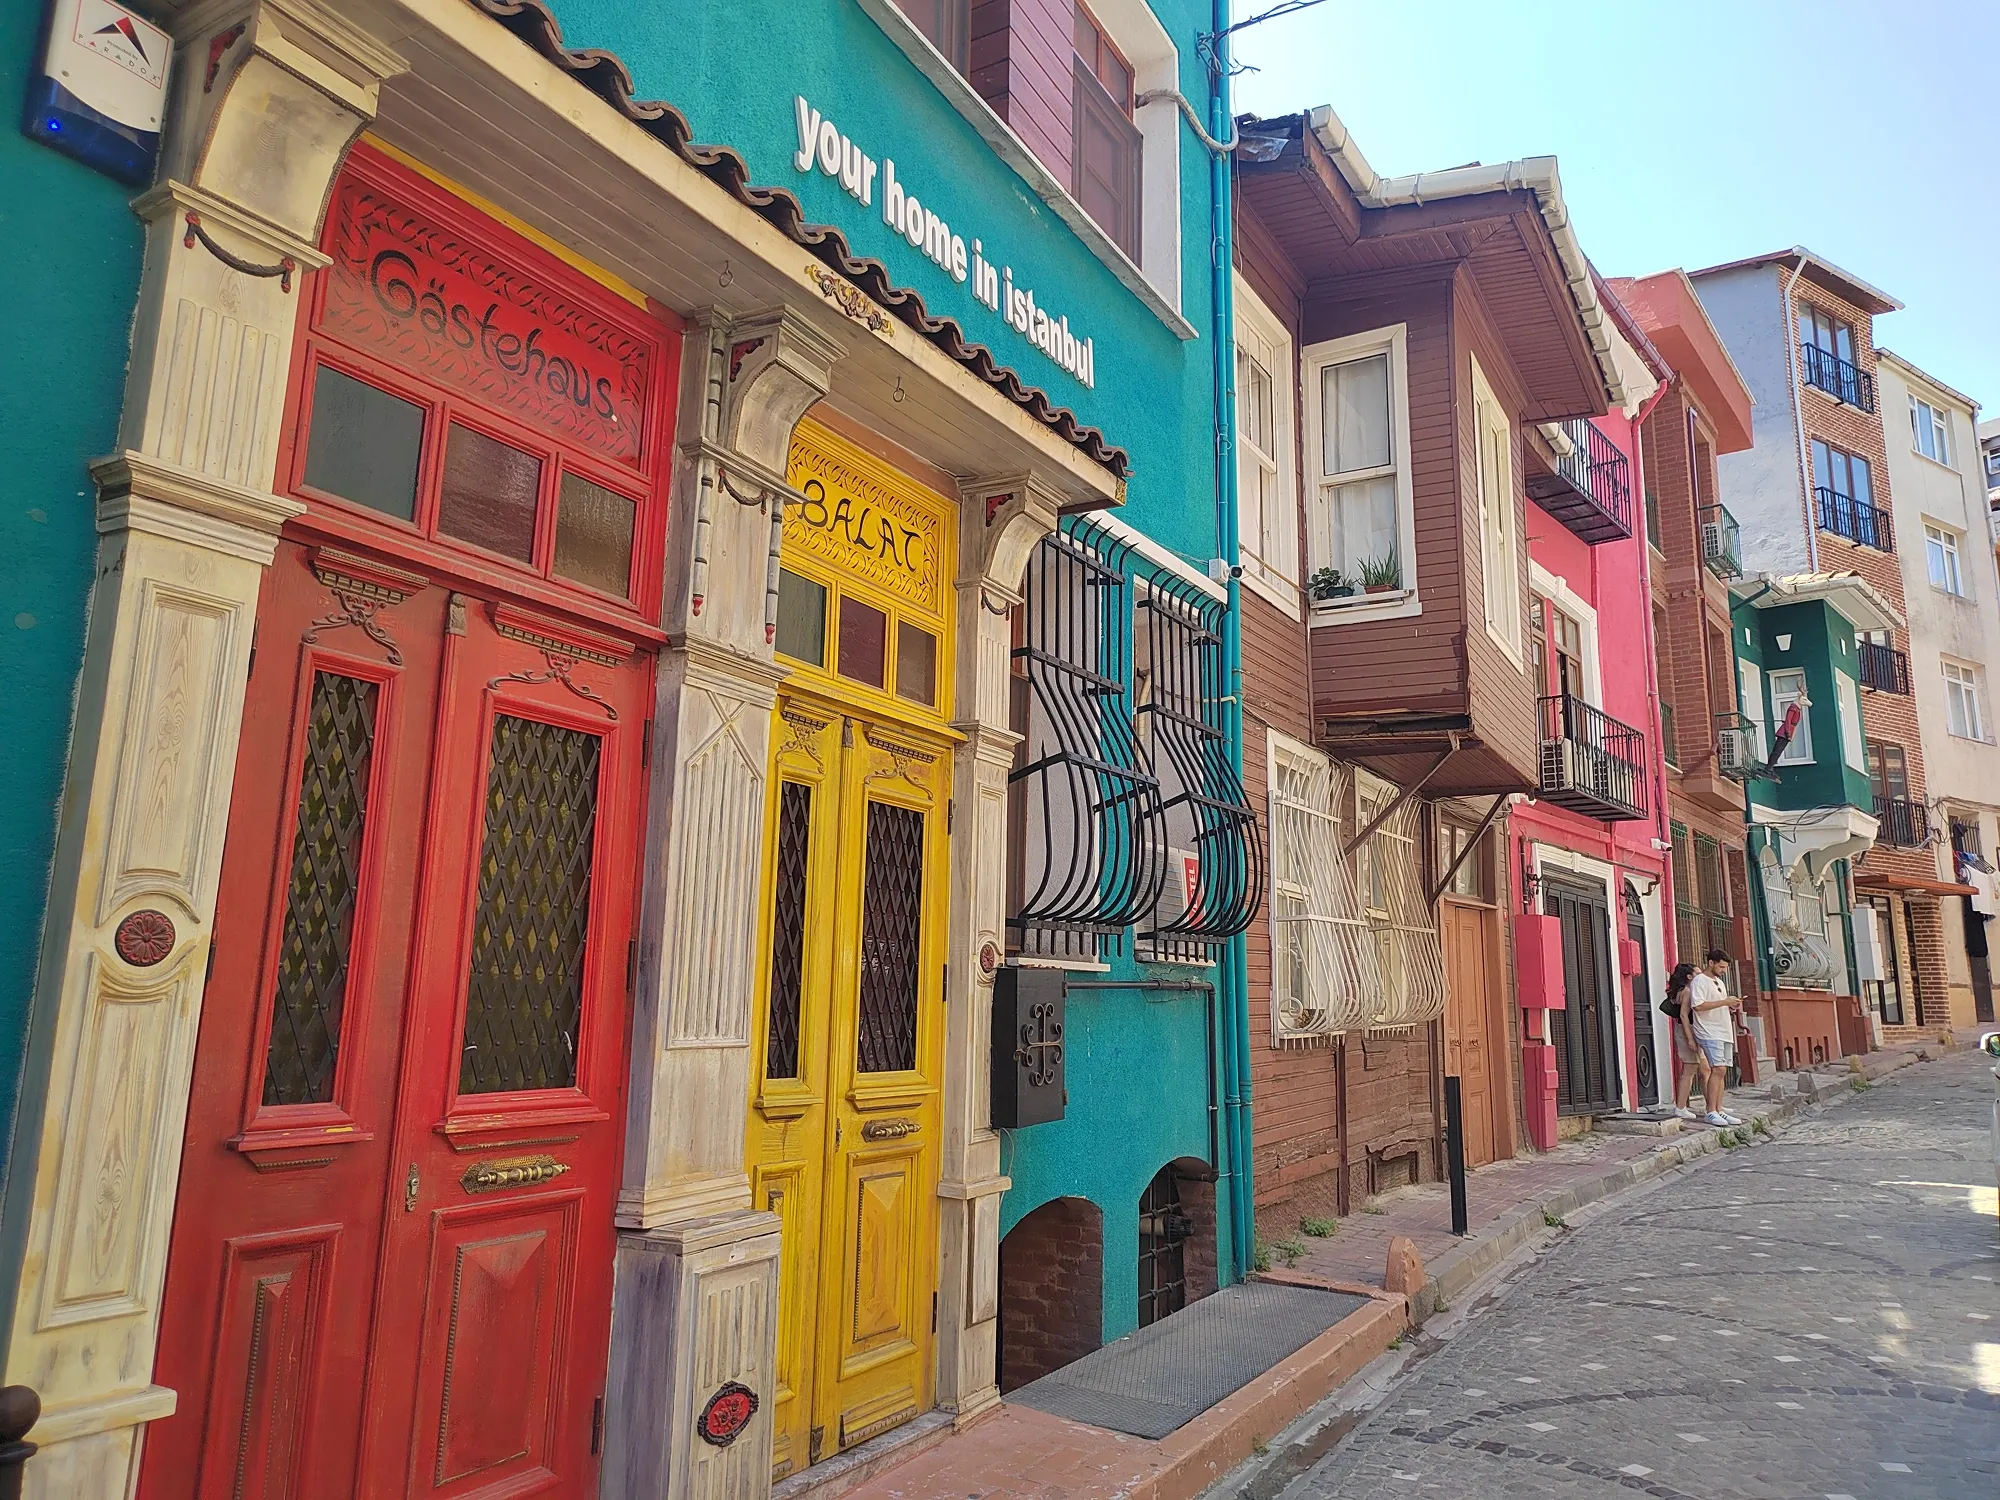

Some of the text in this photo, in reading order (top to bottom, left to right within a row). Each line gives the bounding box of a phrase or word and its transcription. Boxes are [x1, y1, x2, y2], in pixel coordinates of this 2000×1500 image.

[794, 95, 1095, 390] your home in istanbul
[370, 249, 615, 419] Gästehaus
[797, 479, 922, 573] BALAT
